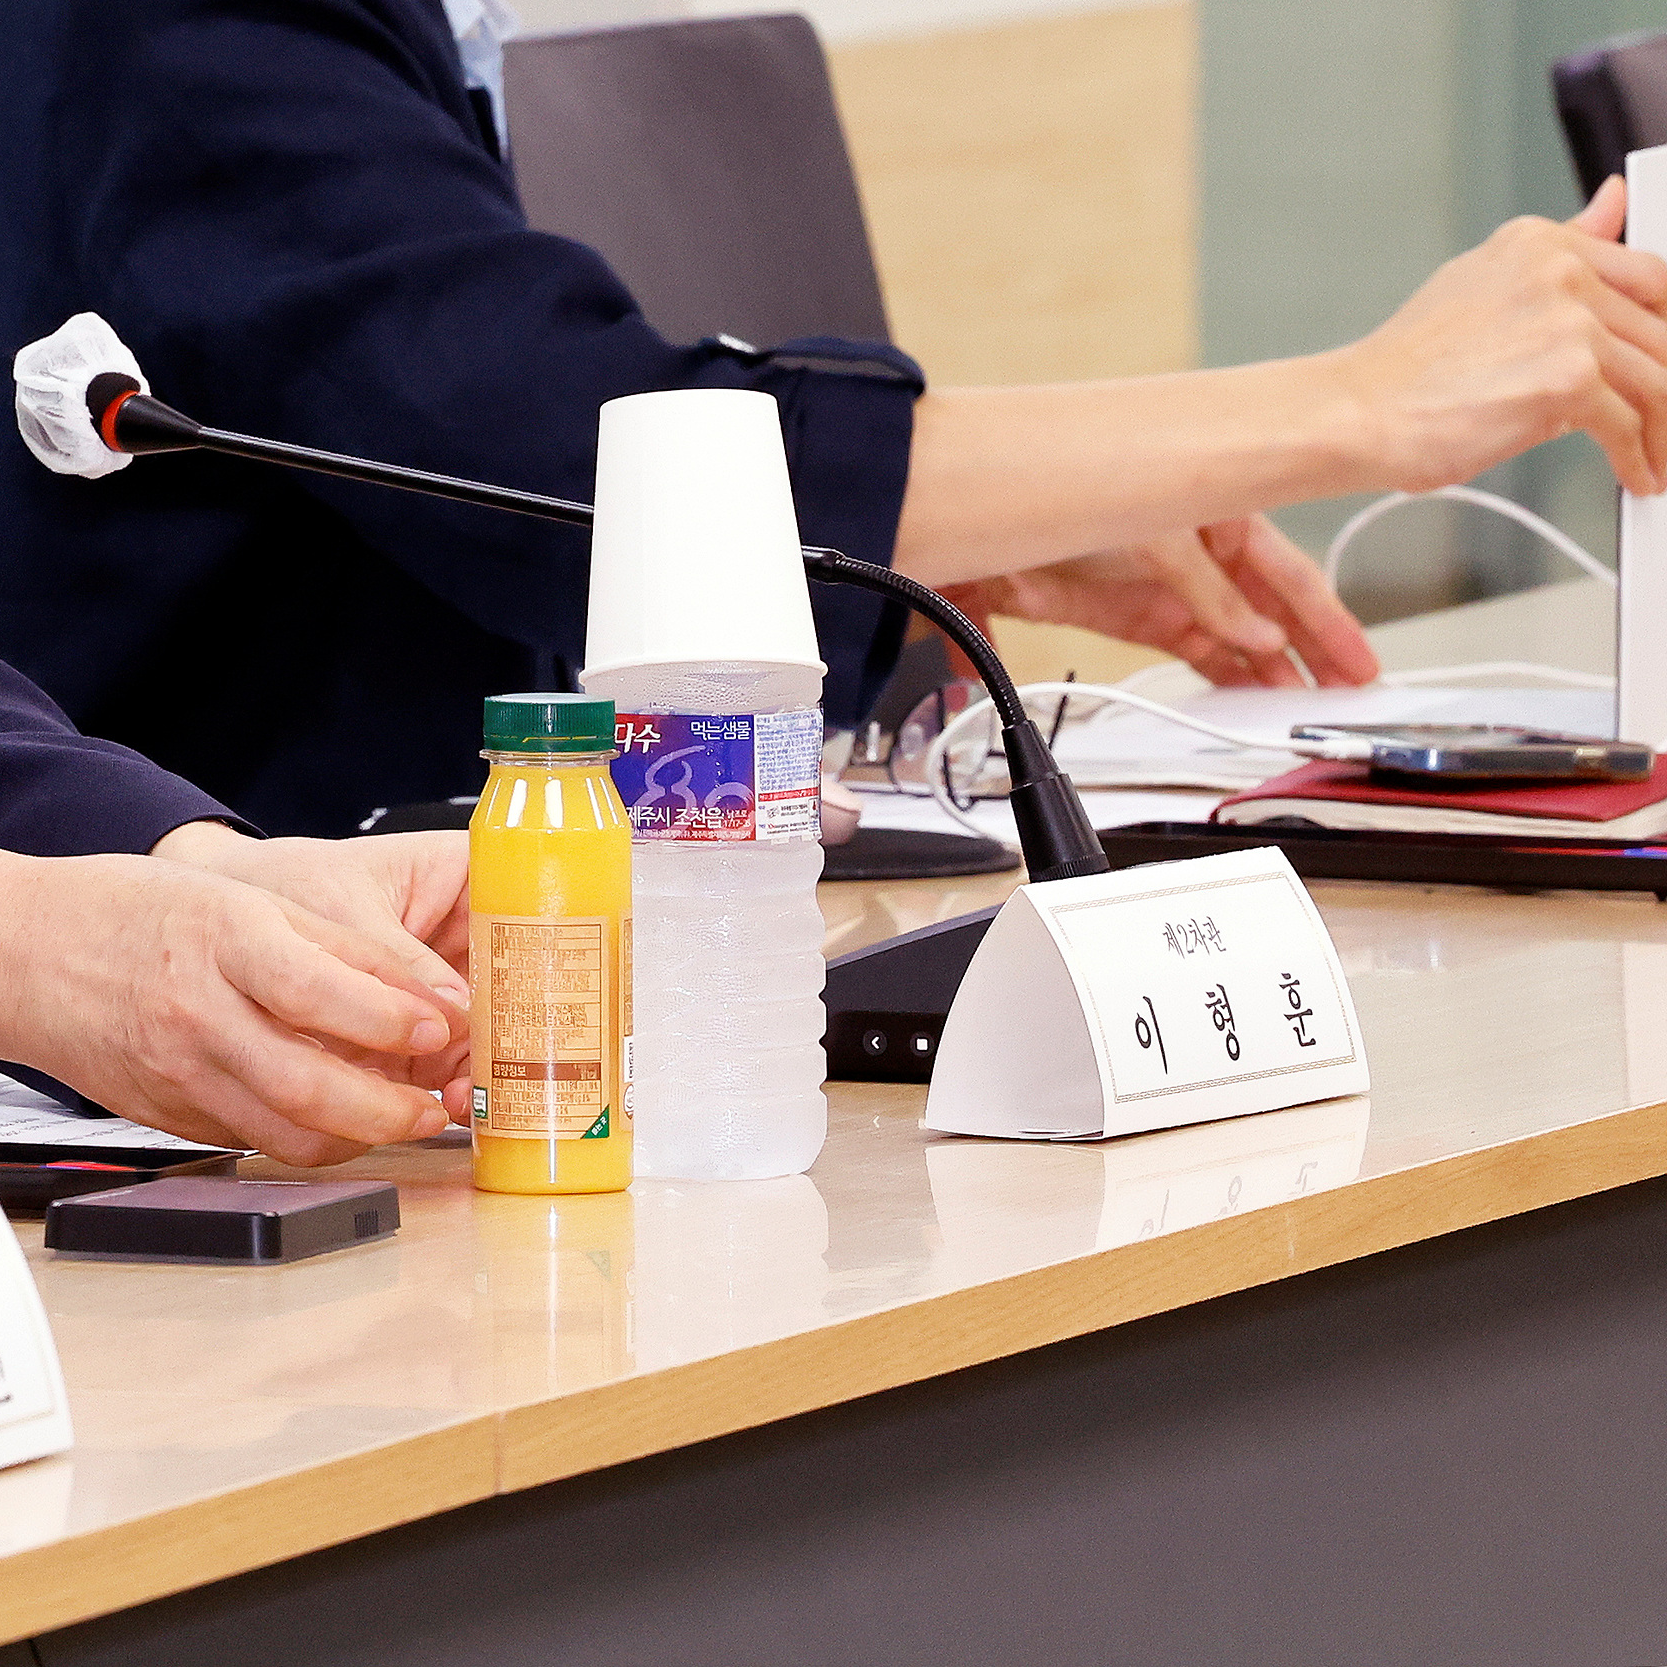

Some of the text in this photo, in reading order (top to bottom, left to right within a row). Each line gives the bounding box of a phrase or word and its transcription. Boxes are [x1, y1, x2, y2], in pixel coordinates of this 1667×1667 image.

[690, 721, 752, 741] 먹는샘물
[626, 805, 724, 829] 제주시 조천읍
[1161, 916, 1227, 960] 제2차관
